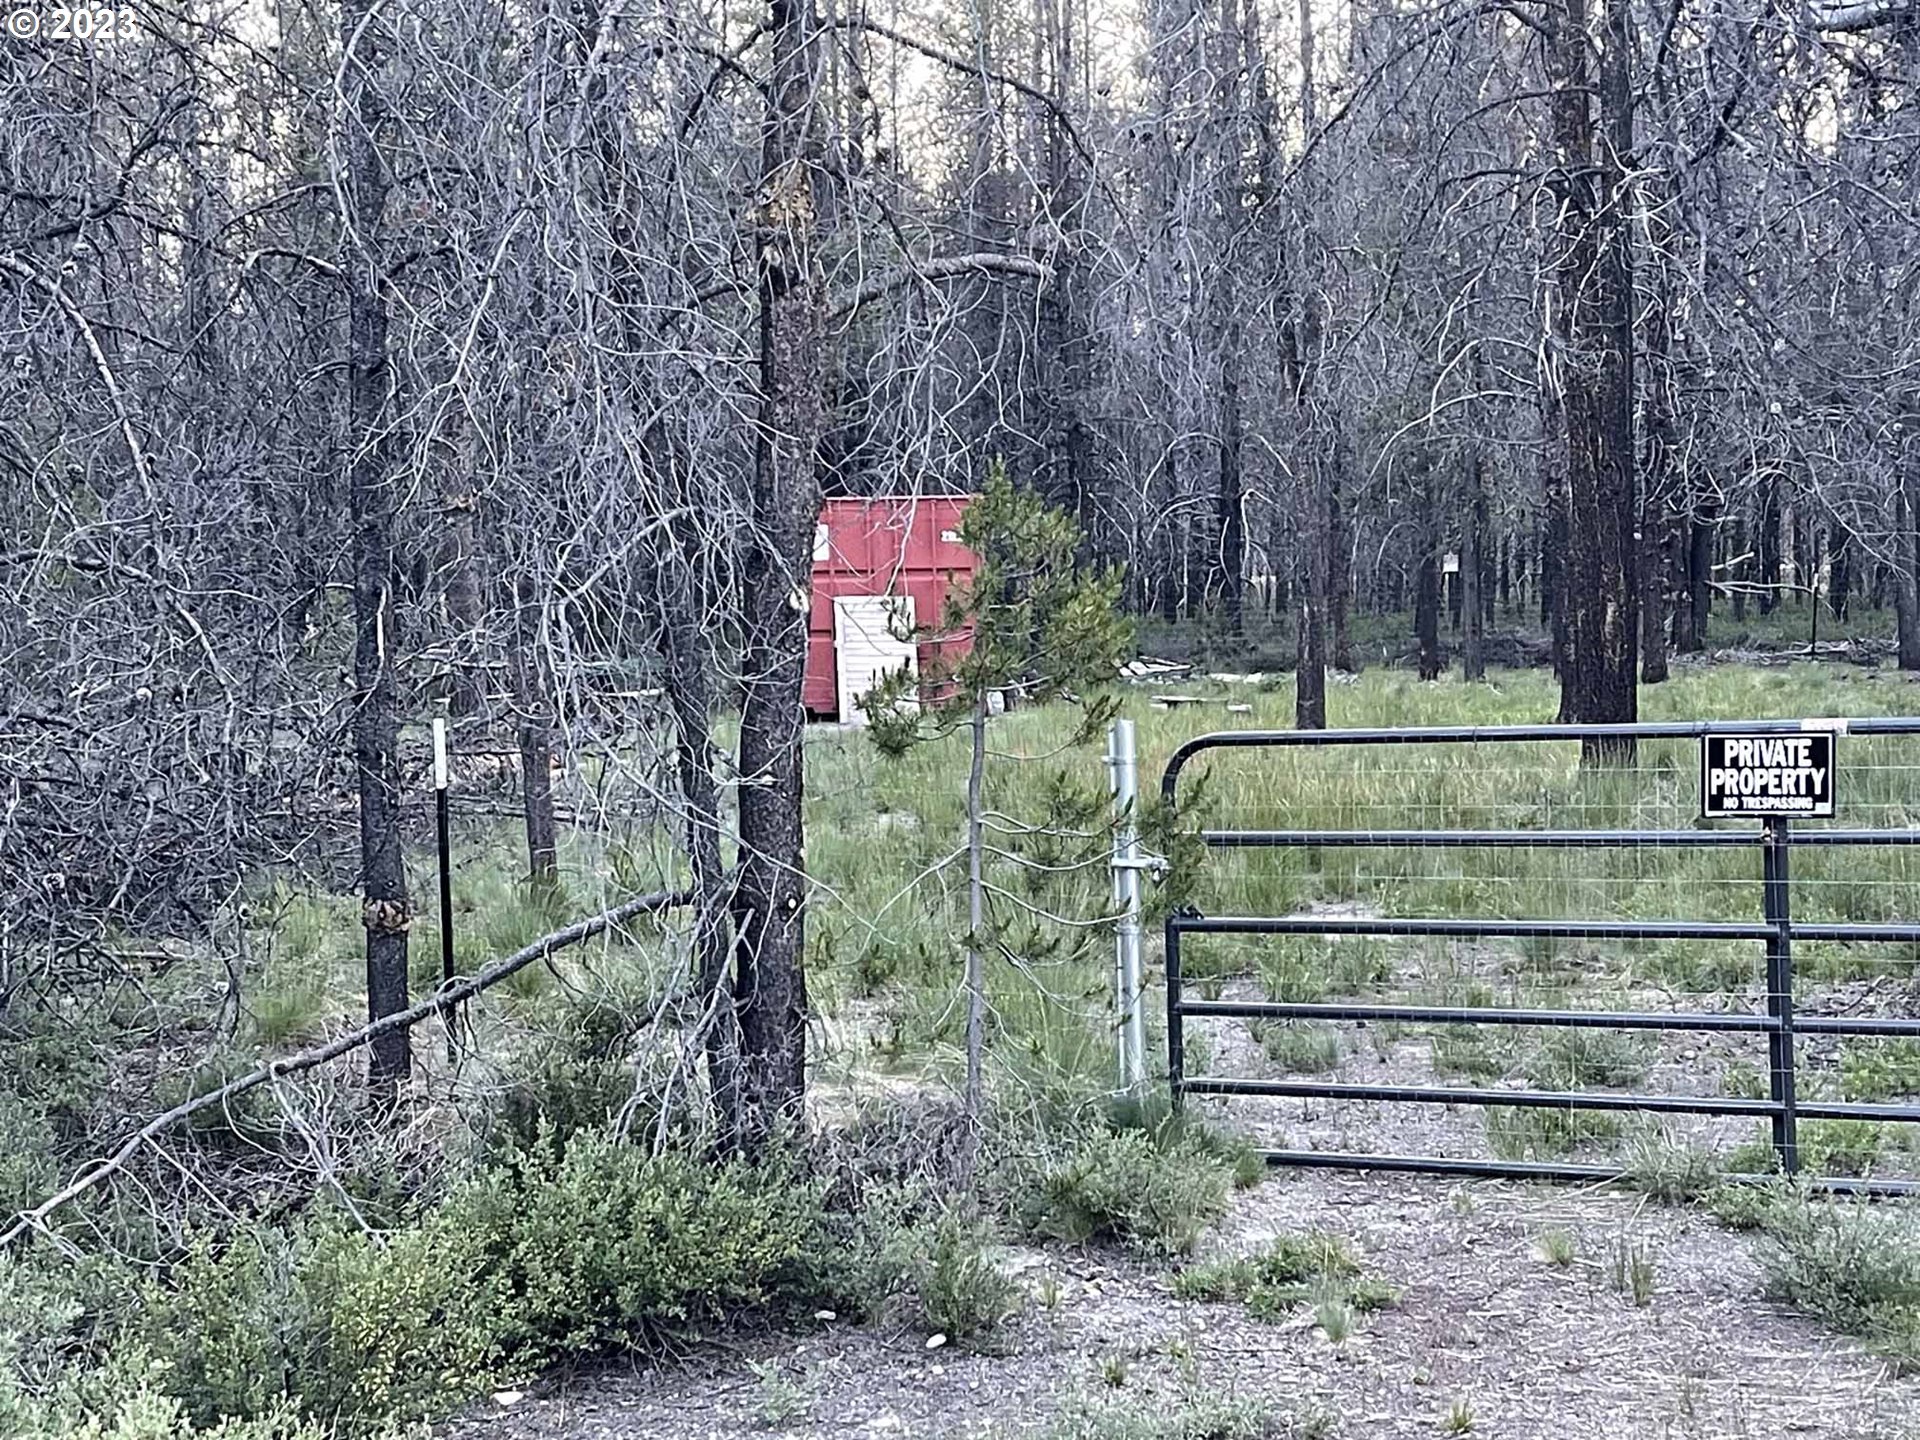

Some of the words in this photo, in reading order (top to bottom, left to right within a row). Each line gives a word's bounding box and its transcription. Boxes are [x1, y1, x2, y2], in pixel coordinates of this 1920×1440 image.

[1724, 738, 1812, 767] PRIVATE
[1710, 767, 1826, 795] PROPERTY
[1723, 796, 1739, 810] NO
[1741, 796, 1814, 810] TRESPASSING
